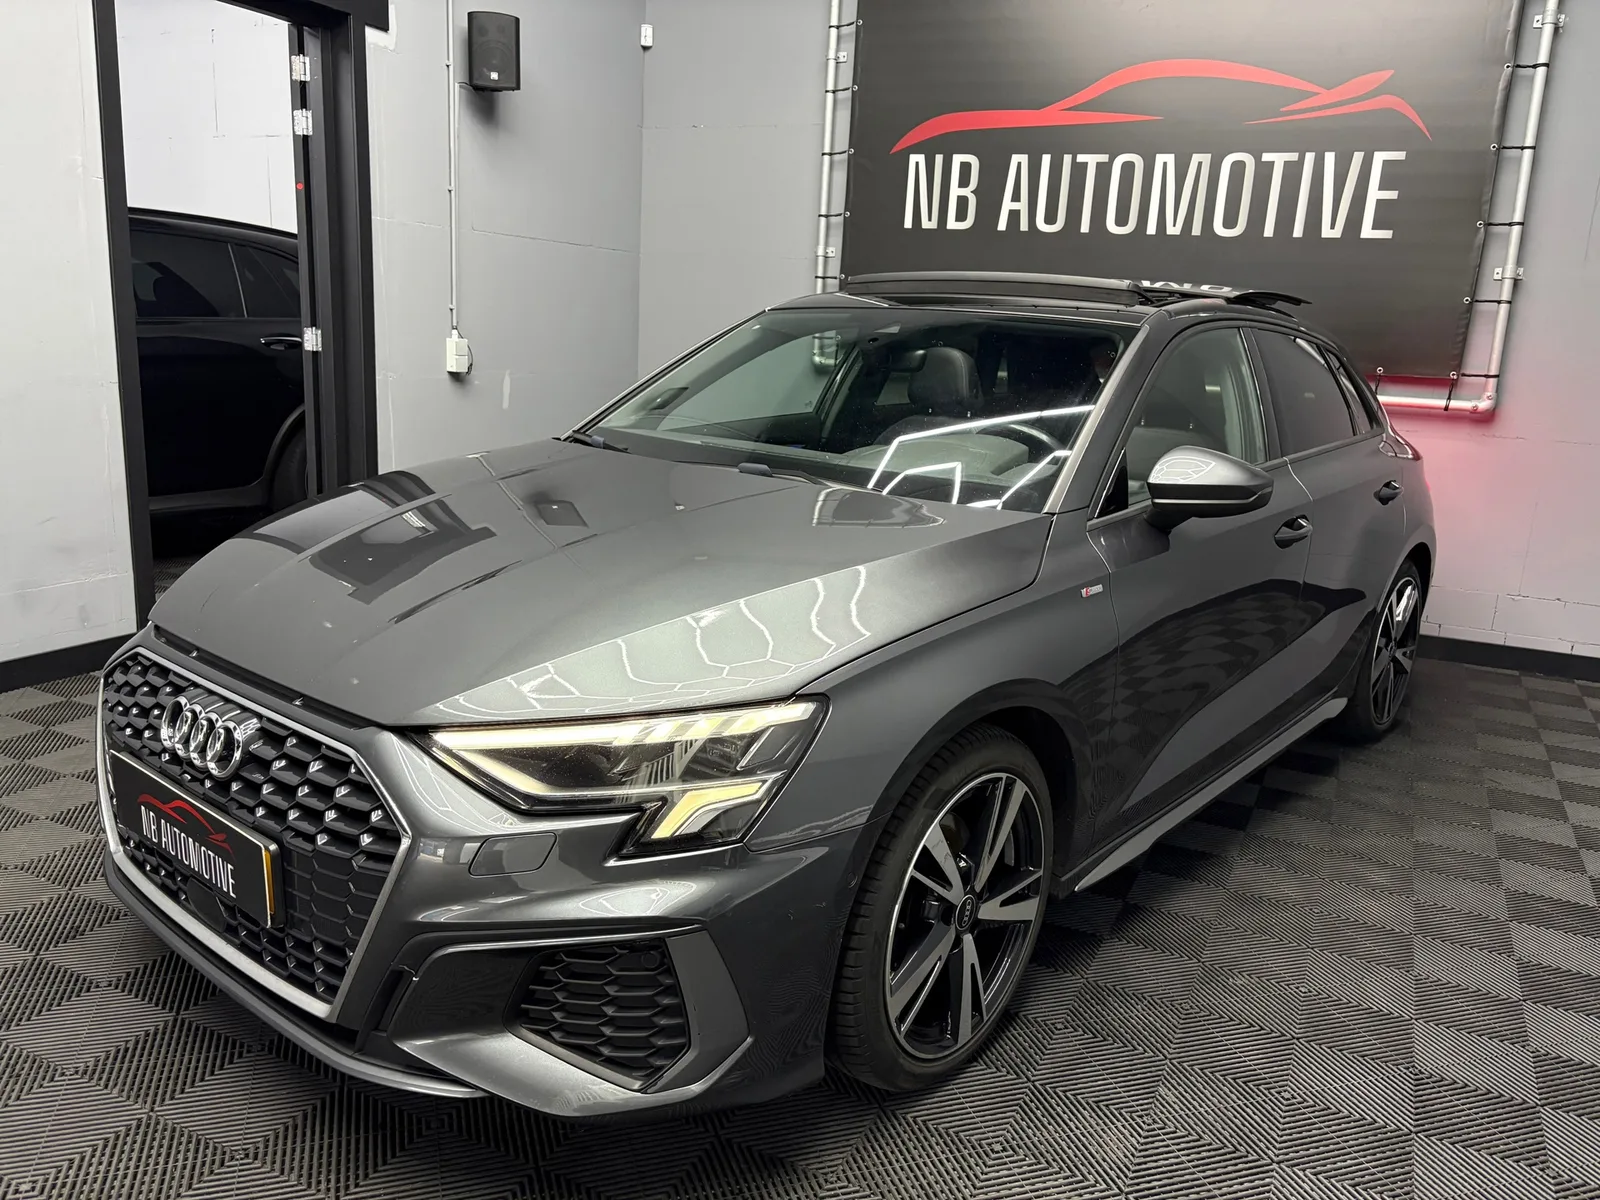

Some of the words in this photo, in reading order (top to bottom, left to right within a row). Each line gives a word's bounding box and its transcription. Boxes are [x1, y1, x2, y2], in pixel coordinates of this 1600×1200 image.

[903, 153, 980, 230] NB
[996, 150, 1406, 239] AUTOMOTIVE
[140, 805, 158, 844] NB
[161, 818, 236, 898] AUTOMOTIVE
